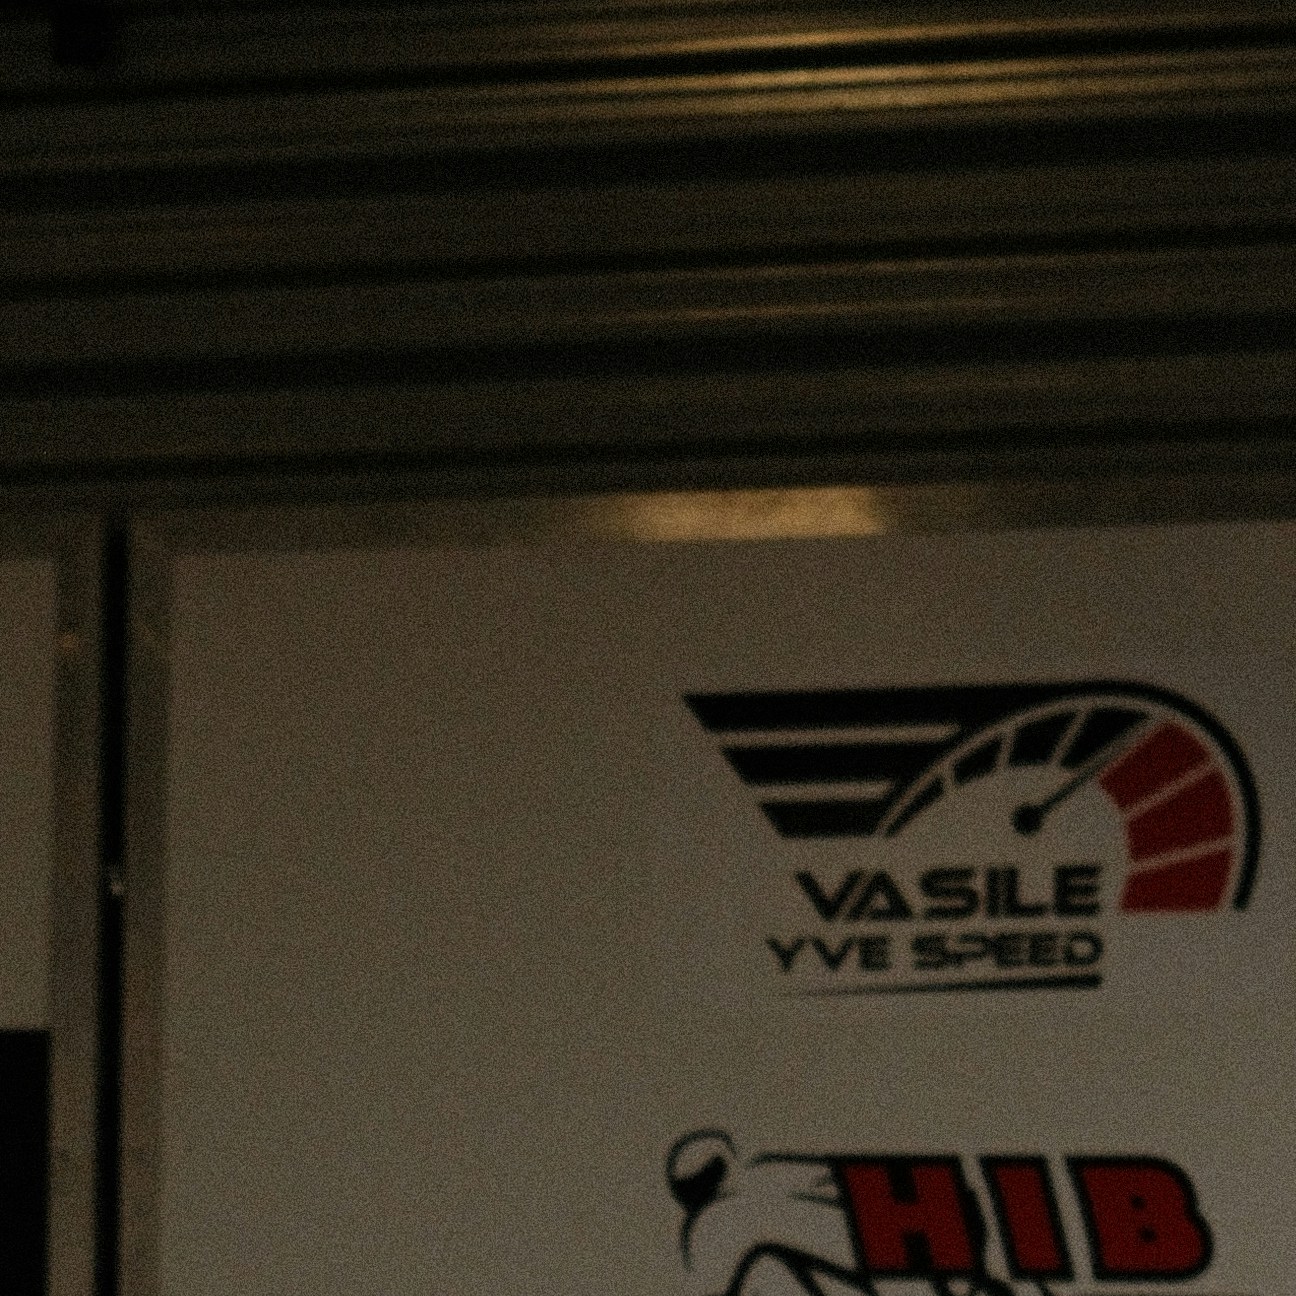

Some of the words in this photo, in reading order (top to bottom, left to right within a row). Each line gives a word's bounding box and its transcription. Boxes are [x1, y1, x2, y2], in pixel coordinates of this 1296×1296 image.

[796, 864, 1102, 922] VASILE
[766, 935, 891, 973] YVE
[911, 931, 1104, 972] SPEED
[834, 1155, 1213, 1282] HIB
